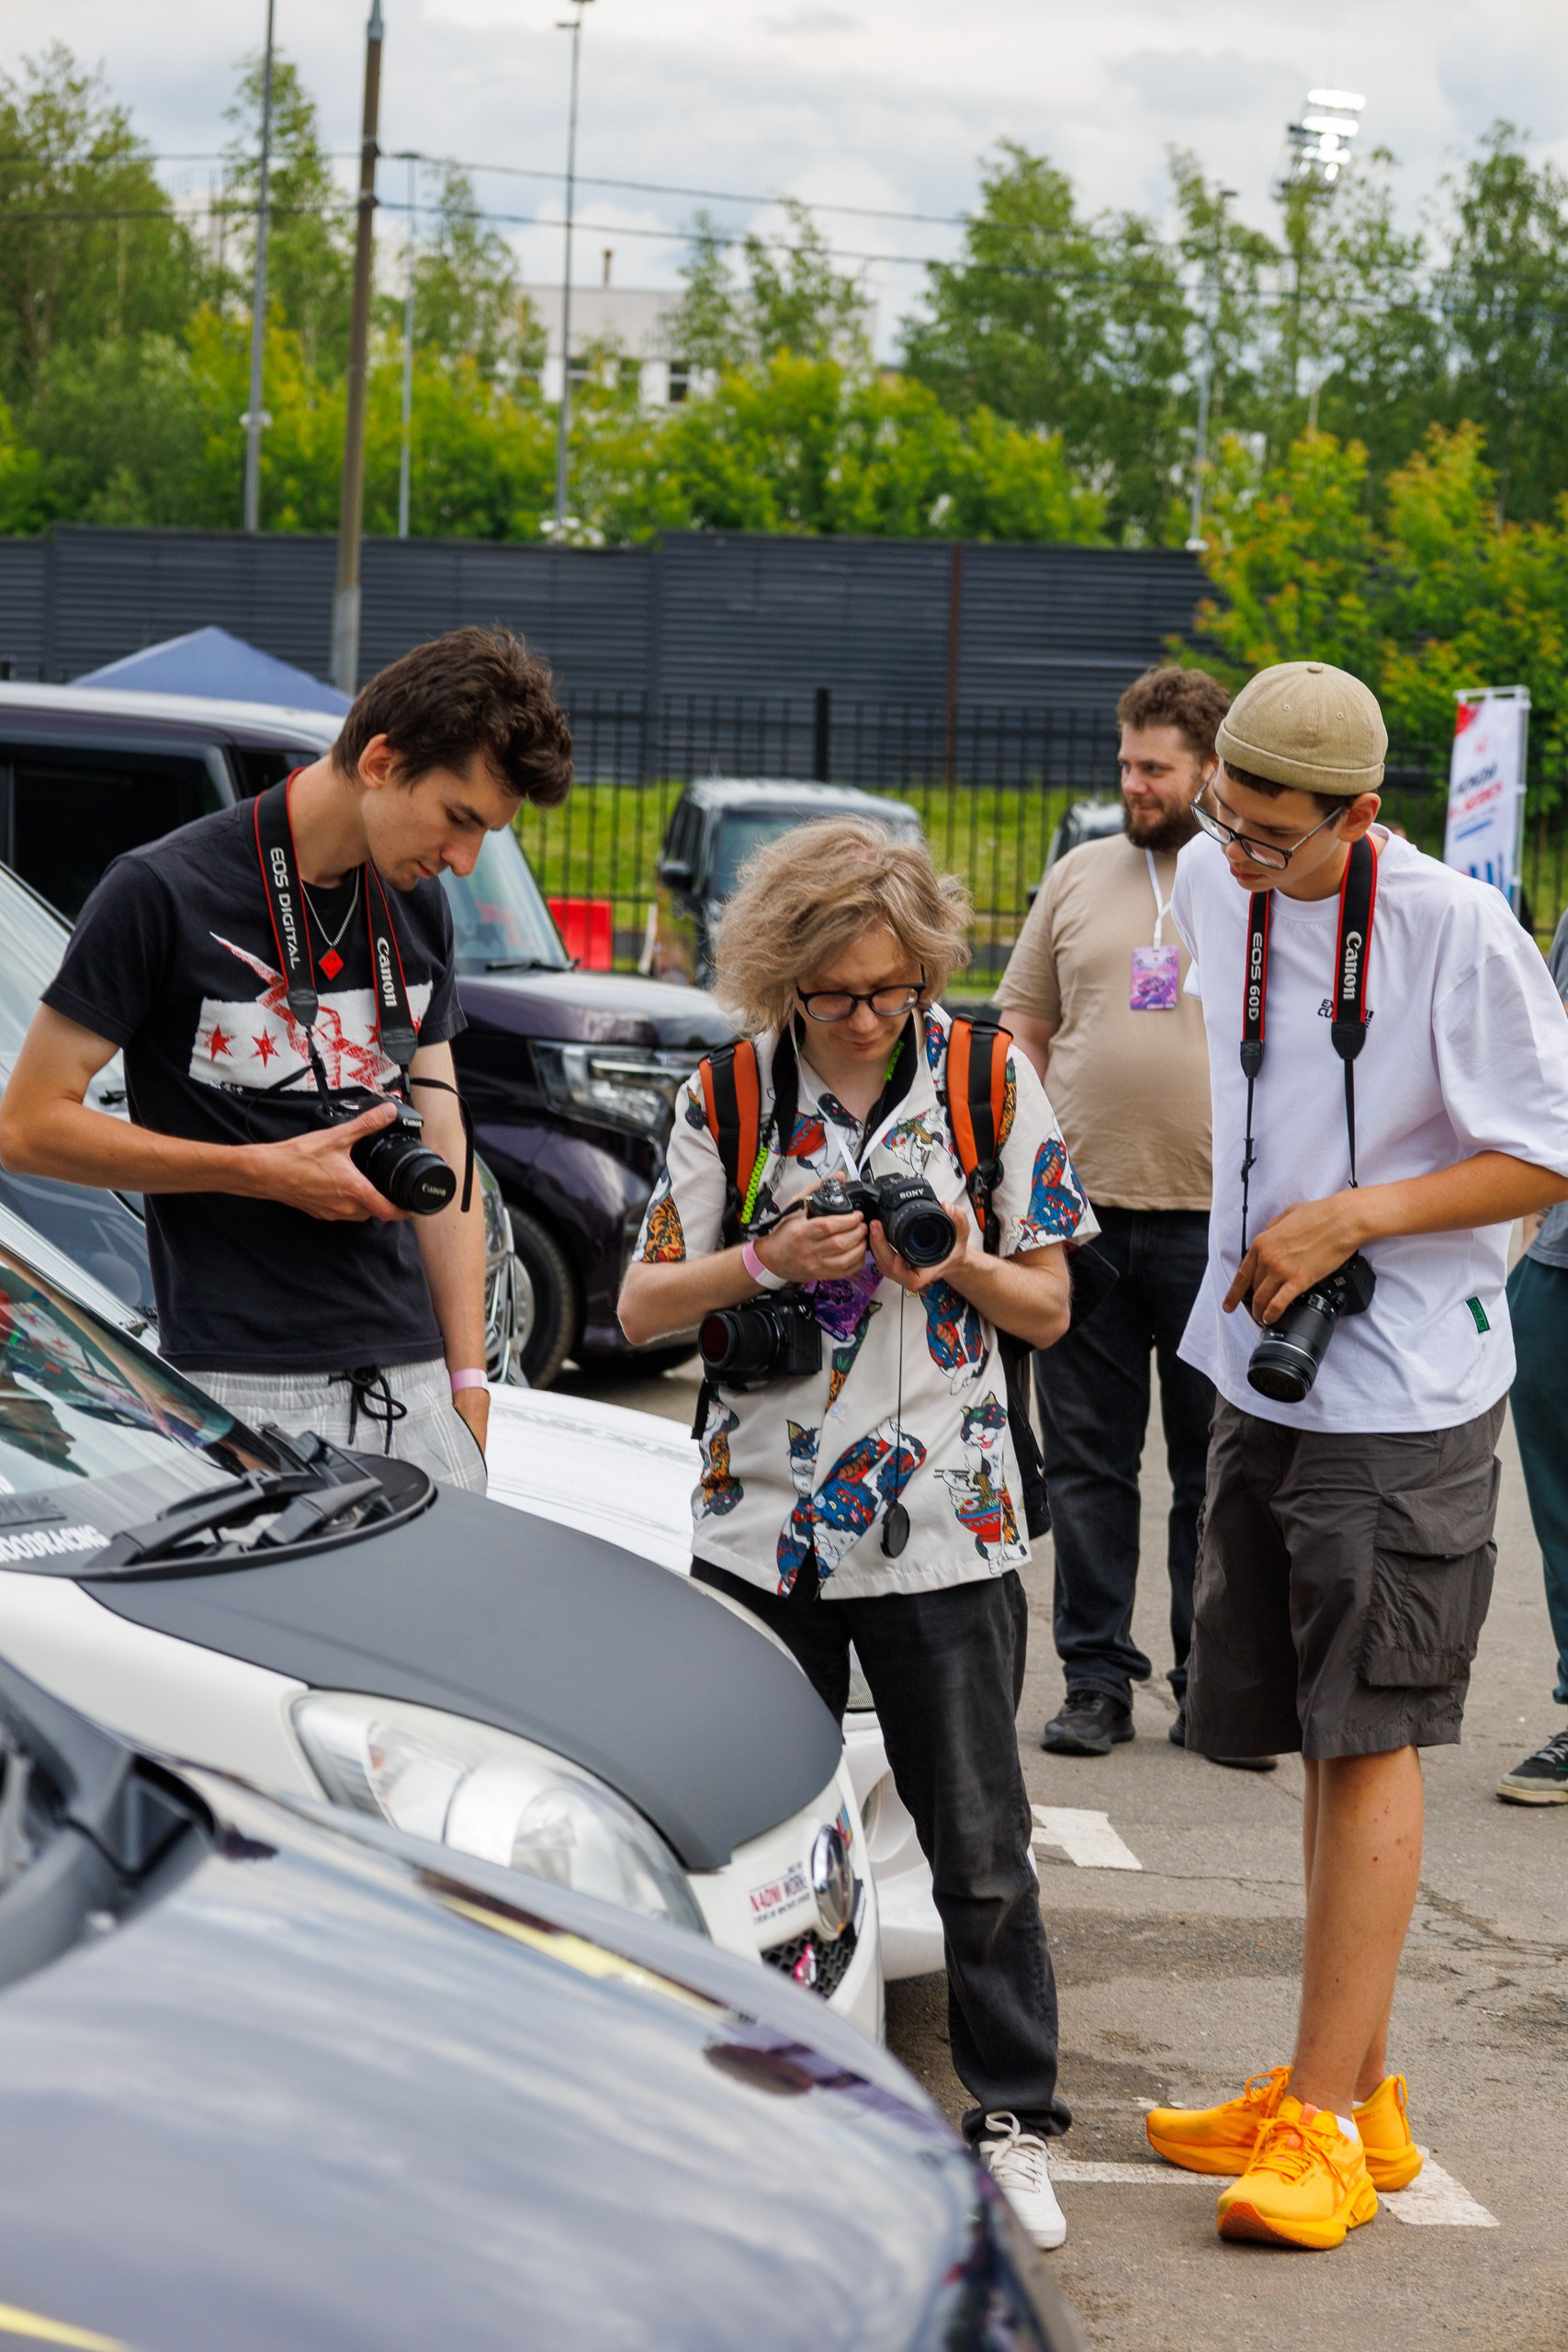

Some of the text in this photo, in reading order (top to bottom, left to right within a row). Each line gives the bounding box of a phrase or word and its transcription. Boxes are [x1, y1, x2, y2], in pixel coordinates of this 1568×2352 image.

[270, 847, 301, 970] EOS DIGITAL
[377, 936, 398, 1008] Canon
[1248, 932, 1263, 1022] EOS 60D
[1343, 931, 1362, 1001] Canon
[402, 1117, 423, 1127] Canon
[422, 1183, 446, 1197] Canon
[899, 1188, 925, 1200] SONY
